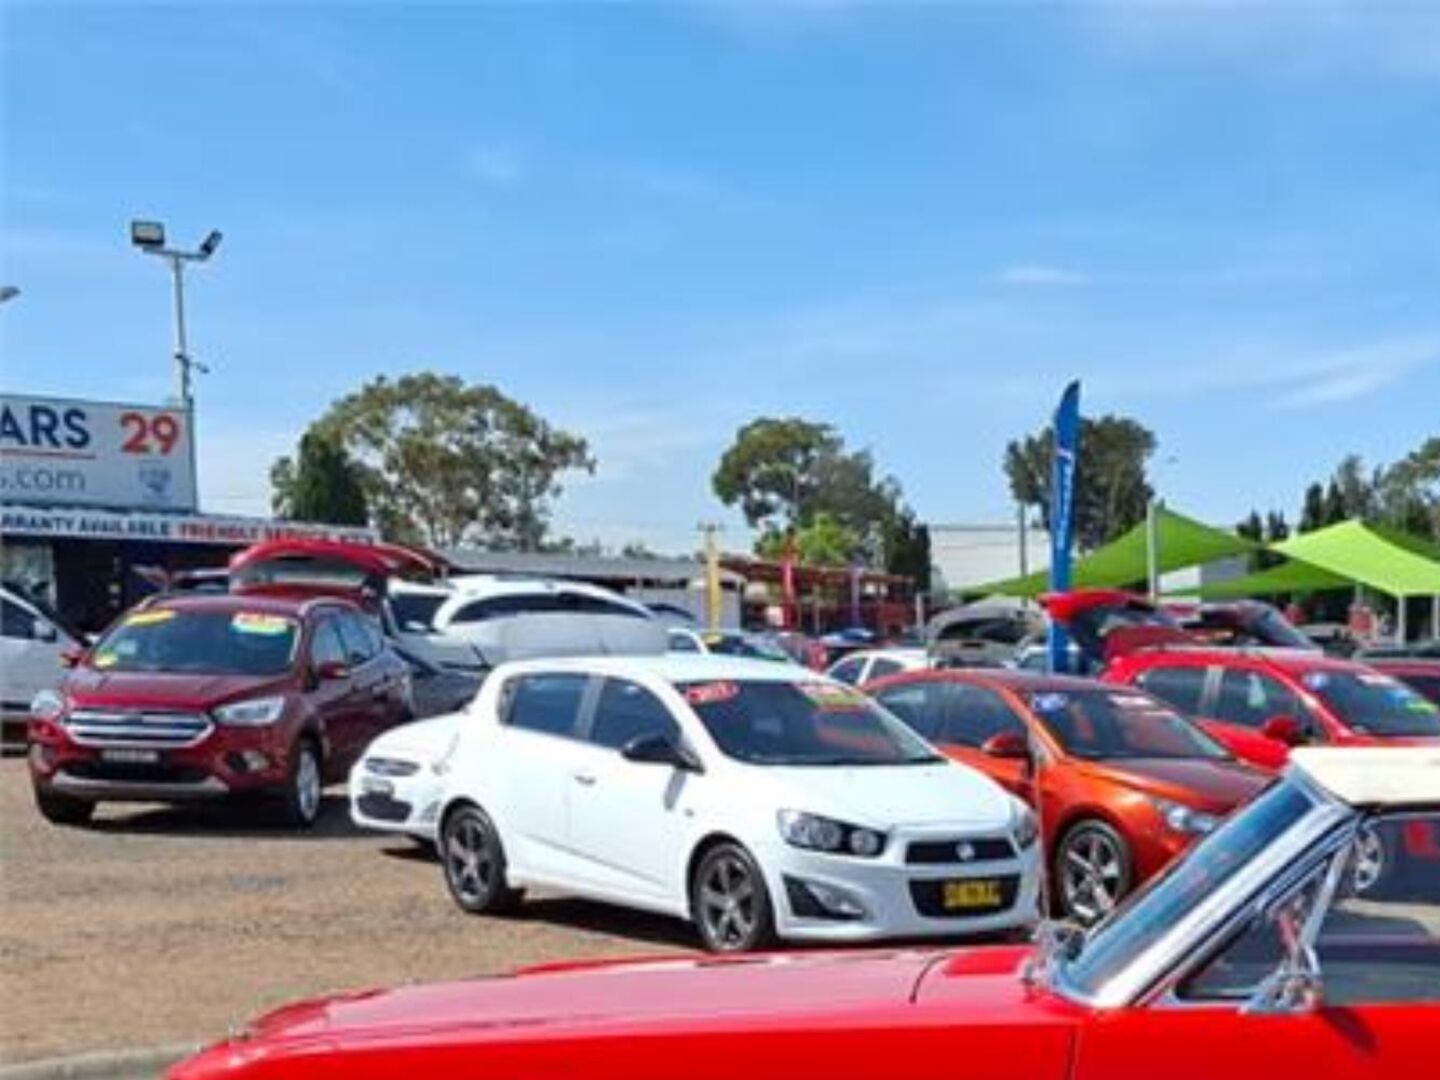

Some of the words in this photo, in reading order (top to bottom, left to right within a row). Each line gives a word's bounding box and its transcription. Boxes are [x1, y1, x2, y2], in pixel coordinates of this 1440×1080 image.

[0, 404, 90, 449] ARS
[120, 412, 179, 455] 29
[79, 516, 170, 535] AVAILABLE
